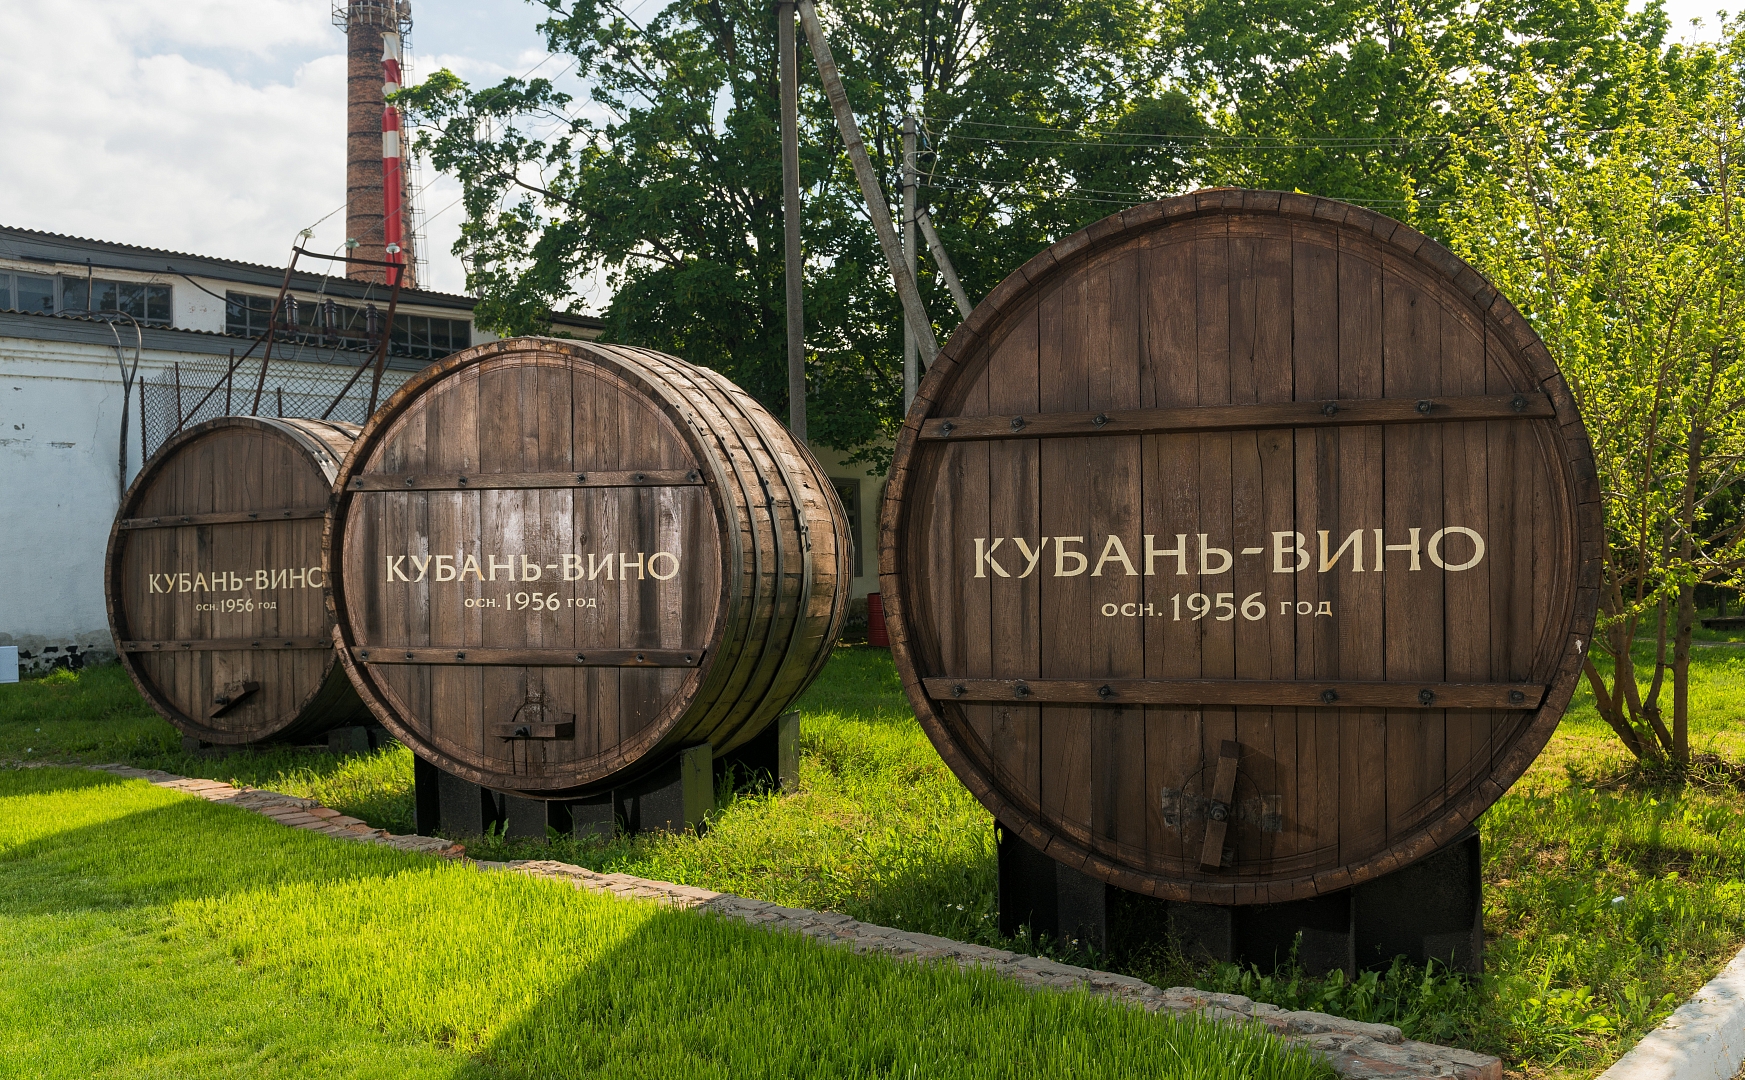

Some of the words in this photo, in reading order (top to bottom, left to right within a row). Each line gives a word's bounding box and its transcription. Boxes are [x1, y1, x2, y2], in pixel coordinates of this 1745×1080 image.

[386, 551, 680, 582] КУБАНЬ-ВИНО
[974, 526, 1486, 579] КУБАНЬ-ВИНО
[195, 603, 219, 612] осн.
[220, 598, 254, 613] 1956
[258, 601, 277, 610] год
[464, 597, 501, 608] осн.
[505, 591, 560, 611] 1956
[567, 597, 597, 609] год
[1100, 602, 1163, 617] осн.
[1170, 592, 1266, 622] 1956
[1280, 601, 1332, 618] год
